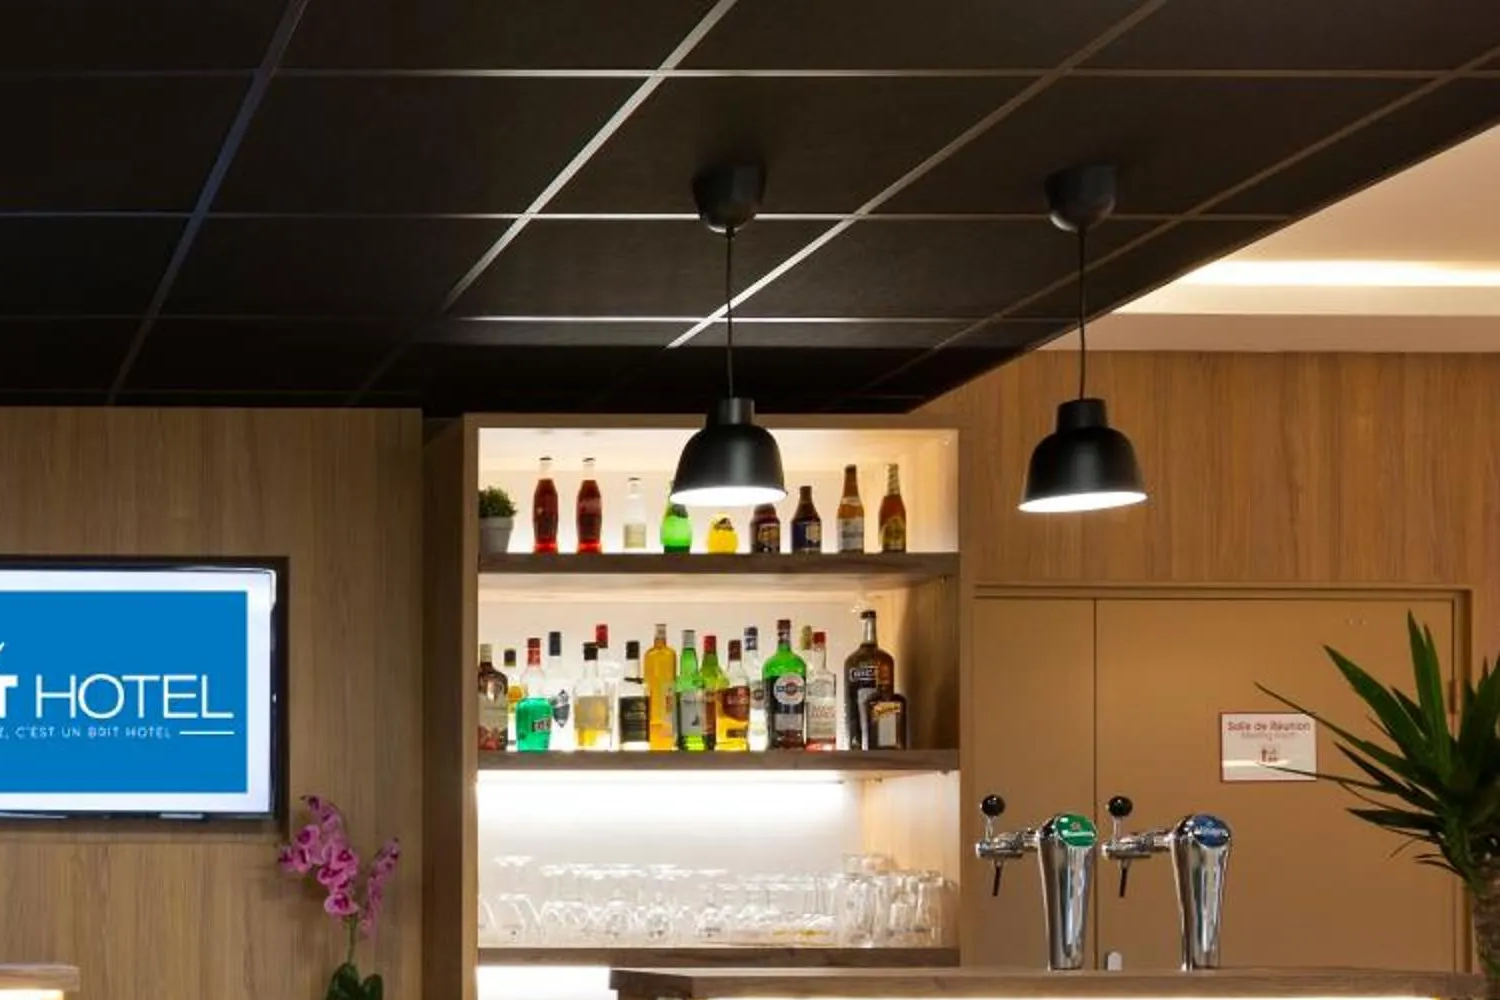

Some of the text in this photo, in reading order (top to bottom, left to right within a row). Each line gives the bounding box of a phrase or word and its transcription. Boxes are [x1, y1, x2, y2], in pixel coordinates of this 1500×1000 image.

[35, 673, 234, 719] HOTEL
[61, 726, 80, 738] UN
[125, 726, 171, 739] HOTEL
